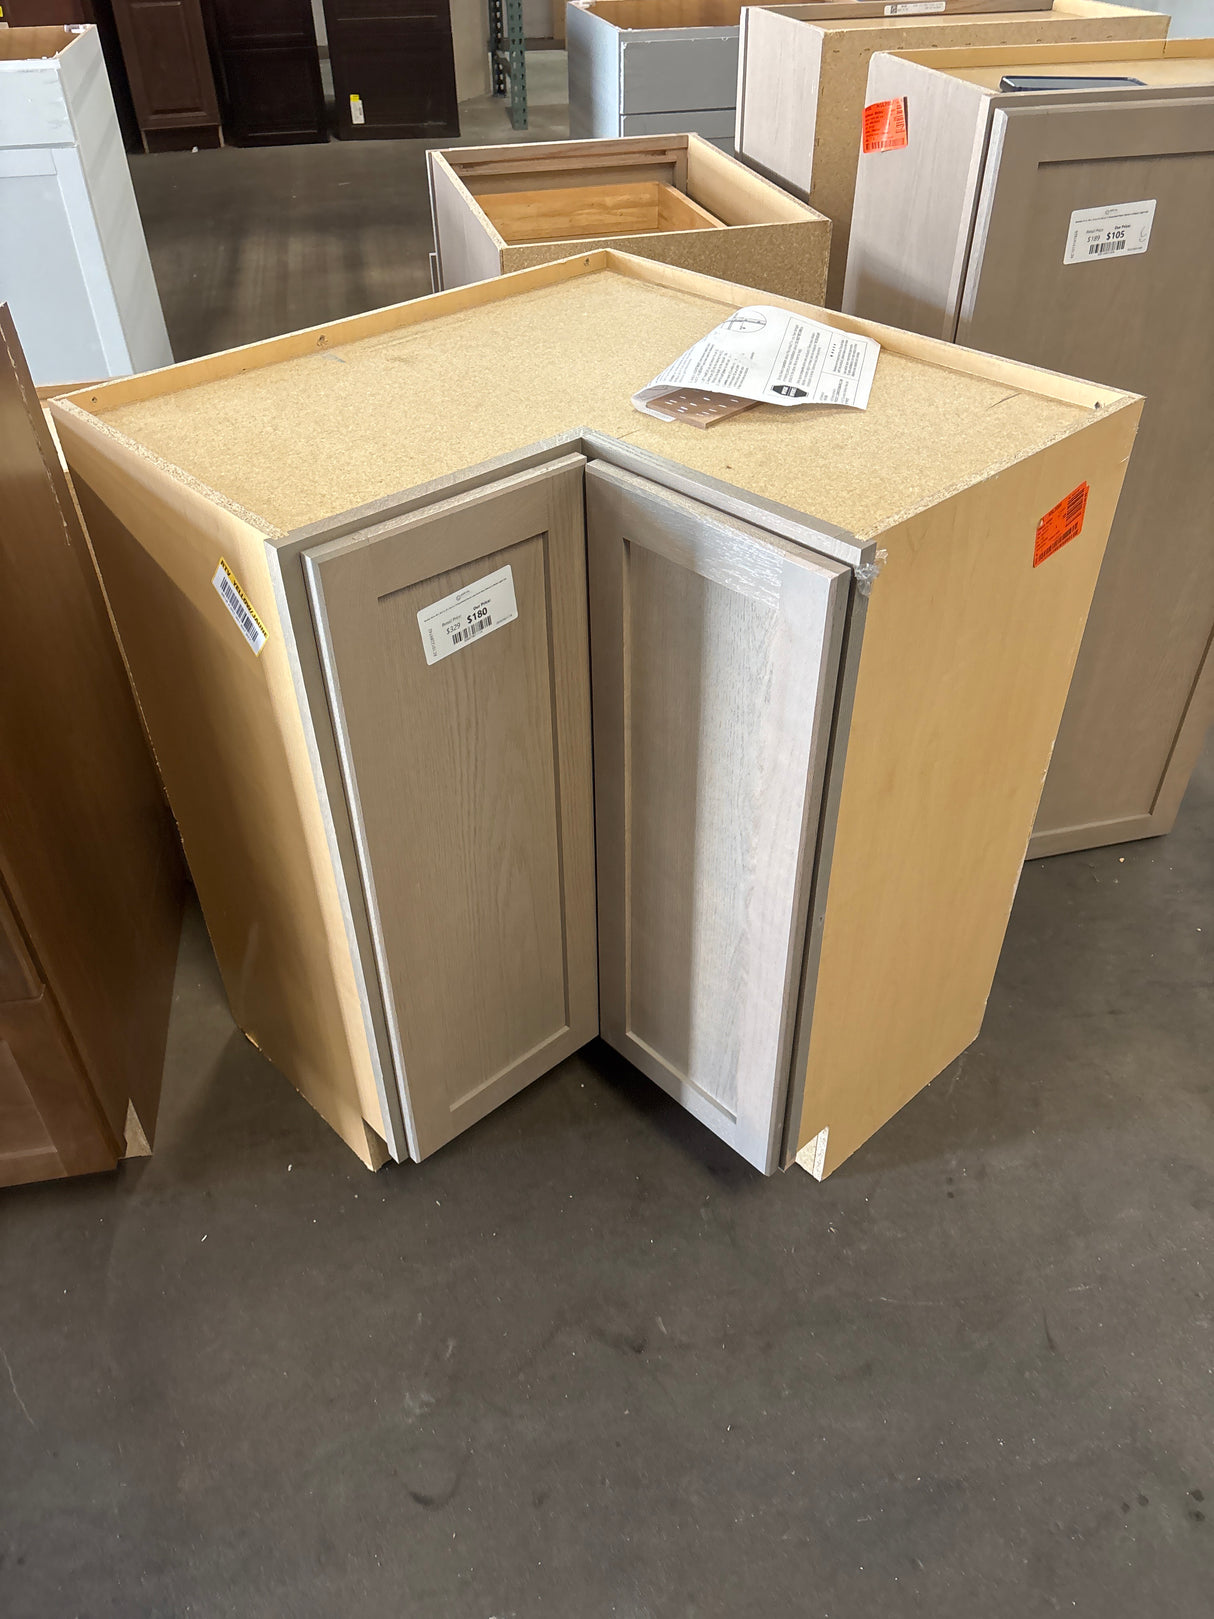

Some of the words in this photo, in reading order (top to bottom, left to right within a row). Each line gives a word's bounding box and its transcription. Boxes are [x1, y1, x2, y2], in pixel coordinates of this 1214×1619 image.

[1087, 235, 1101, 243] $189
[1106, 230, 1125, 241] $105
[220, 559, 231, 577] RTV
[233, 580, 268, 638] YELLOW/JAUNE
[466, 607, 488, 624] $180
[446, 622, 461, 635] $329
